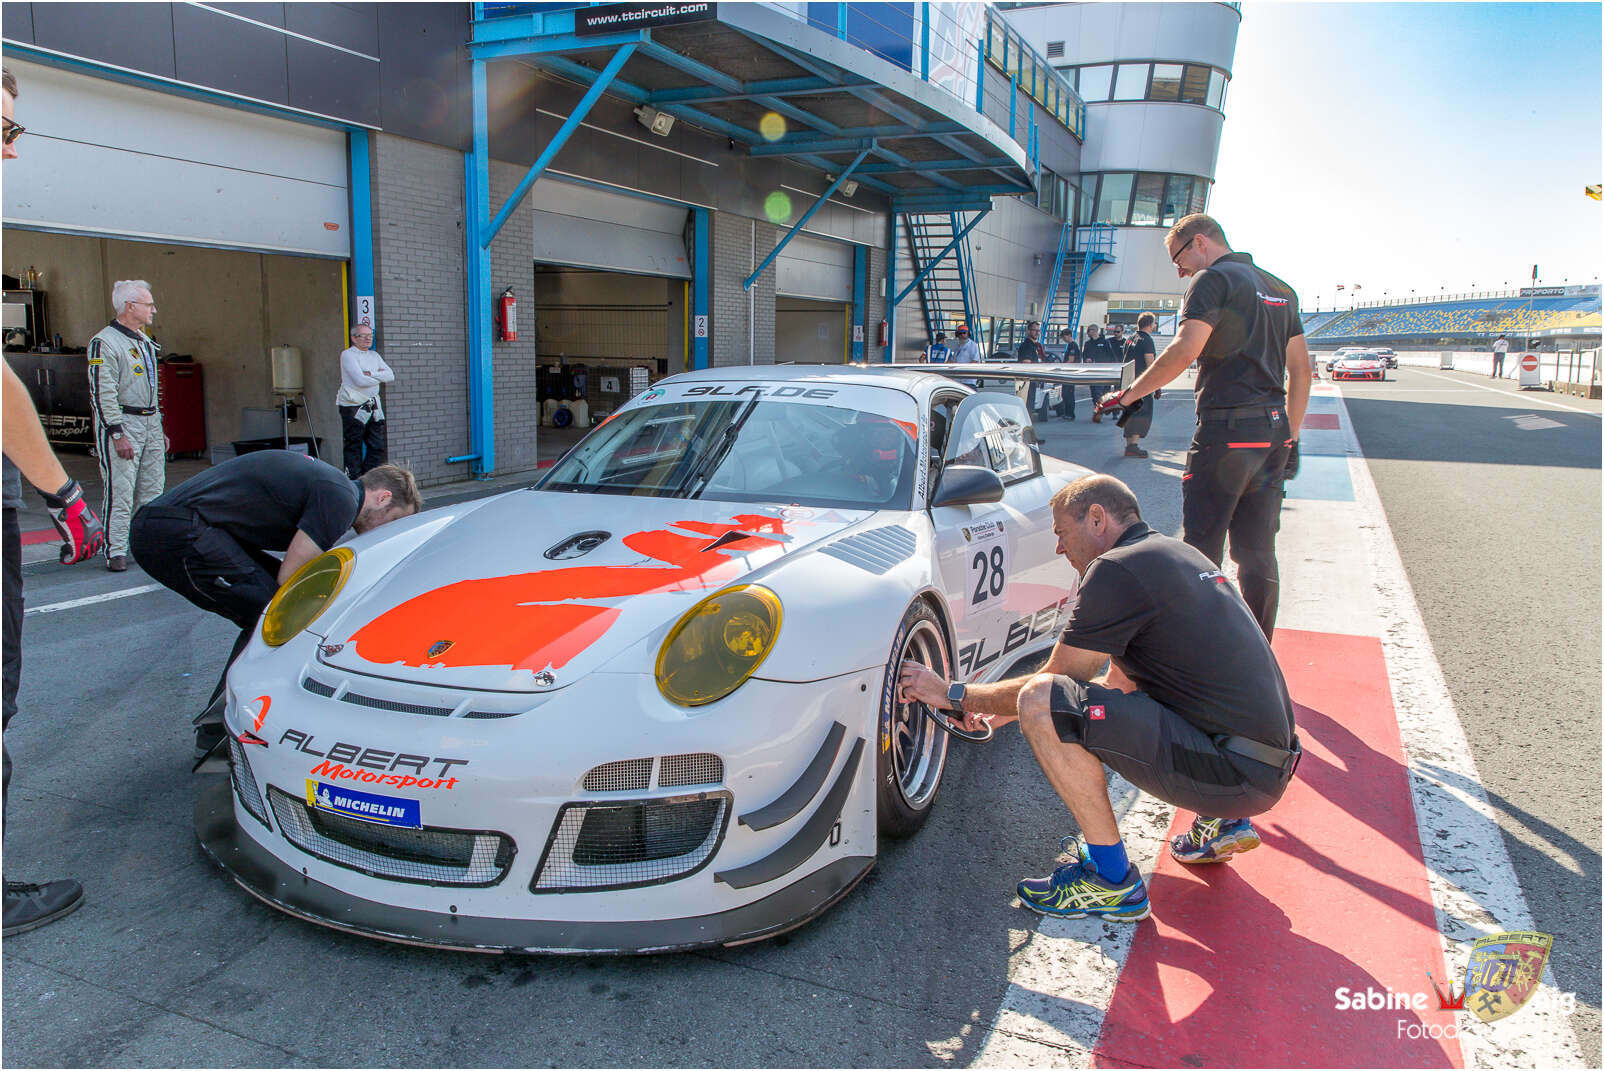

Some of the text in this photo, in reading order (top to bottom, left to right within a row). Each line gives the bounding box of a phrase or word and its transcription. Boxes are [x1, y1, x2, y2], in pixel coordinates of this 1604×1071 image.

[587, 2, 708, 26] www.ttcircuit.com
[362, 299, 369, 314] 3
[698, 317, 705, 328] 2
[39, 414, 91, 428] BERT
[972, 545, 1005, 606] 28
[884, 628, 904, 715] MICHELIN
[279, 728, 470, 778] ALBERT
[310, 759, 461, 790] Motorsport
[333, 795, 406, 818] MICHELIN
